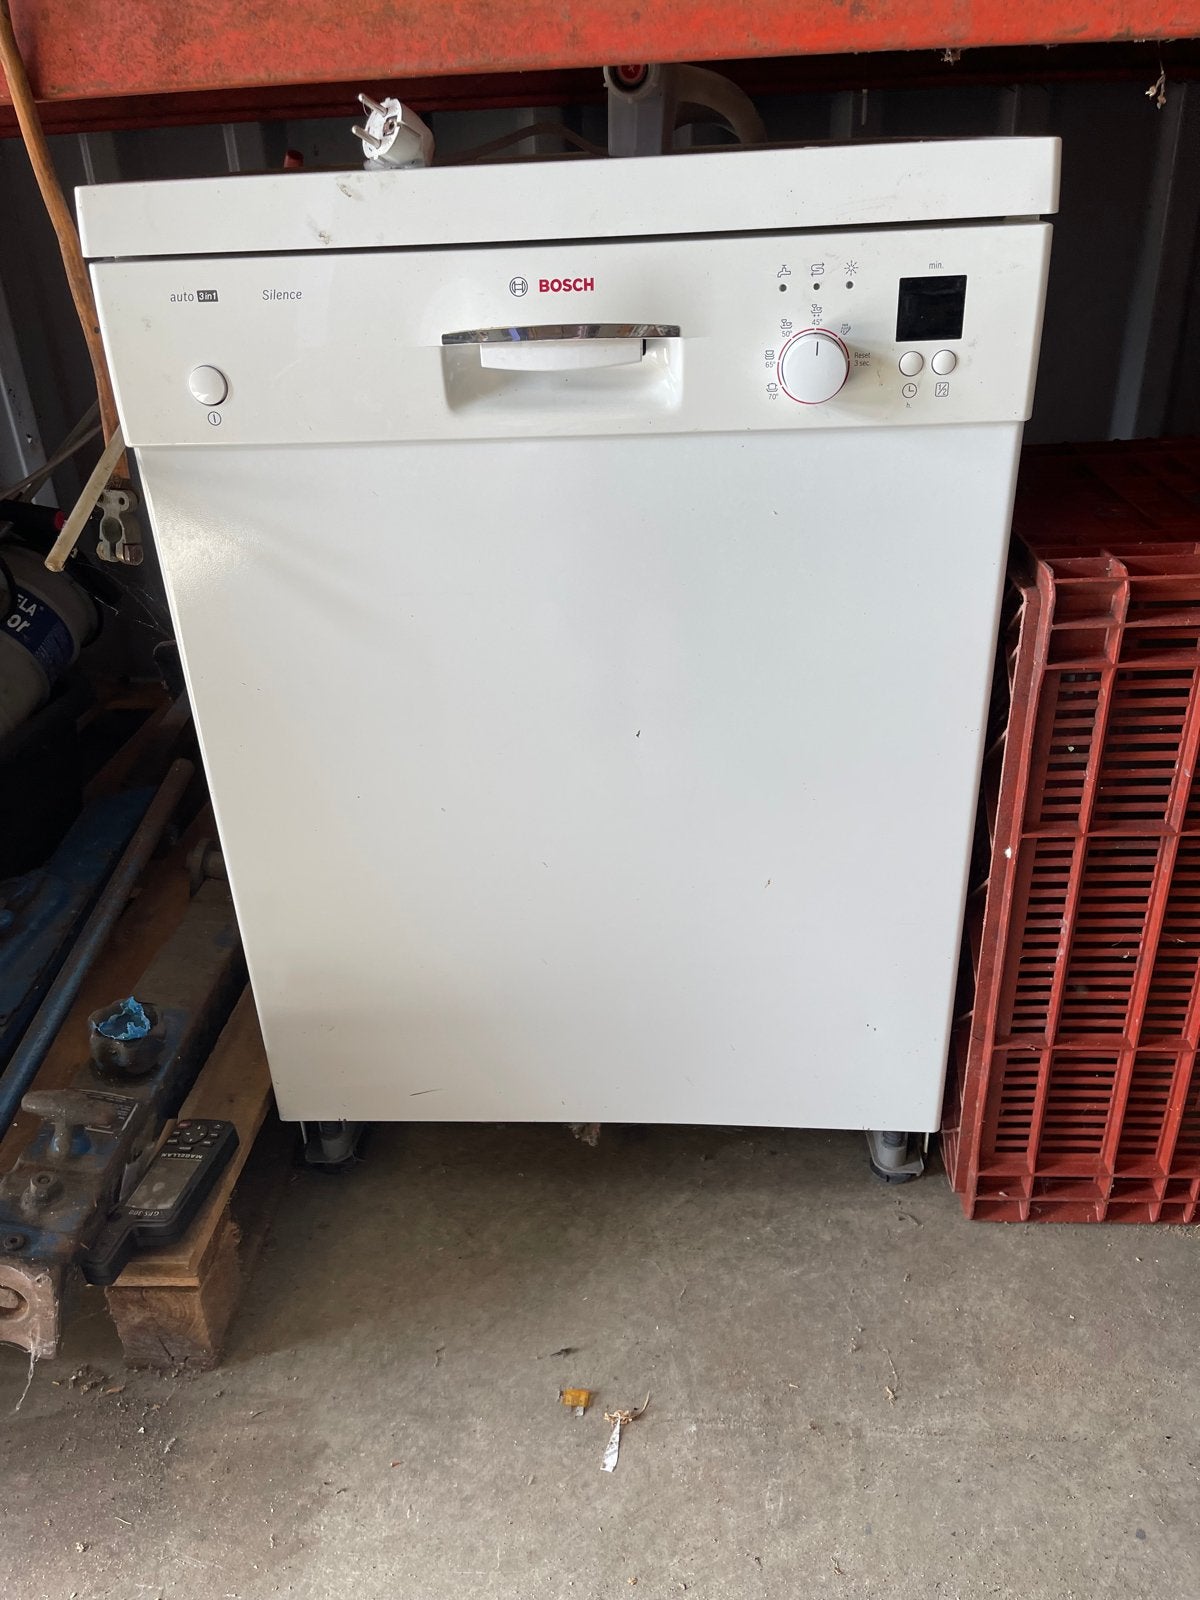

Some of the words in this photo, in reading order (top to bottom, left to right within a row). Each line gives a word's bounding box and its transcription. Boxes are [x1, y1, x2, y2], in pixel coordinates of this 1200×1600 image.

[928, 261, 944, 270] min.
[538, 277, 595, 292] BOSCH
[170, 292, 194, 302] auto
[262, 289, 302, 300] Silence
